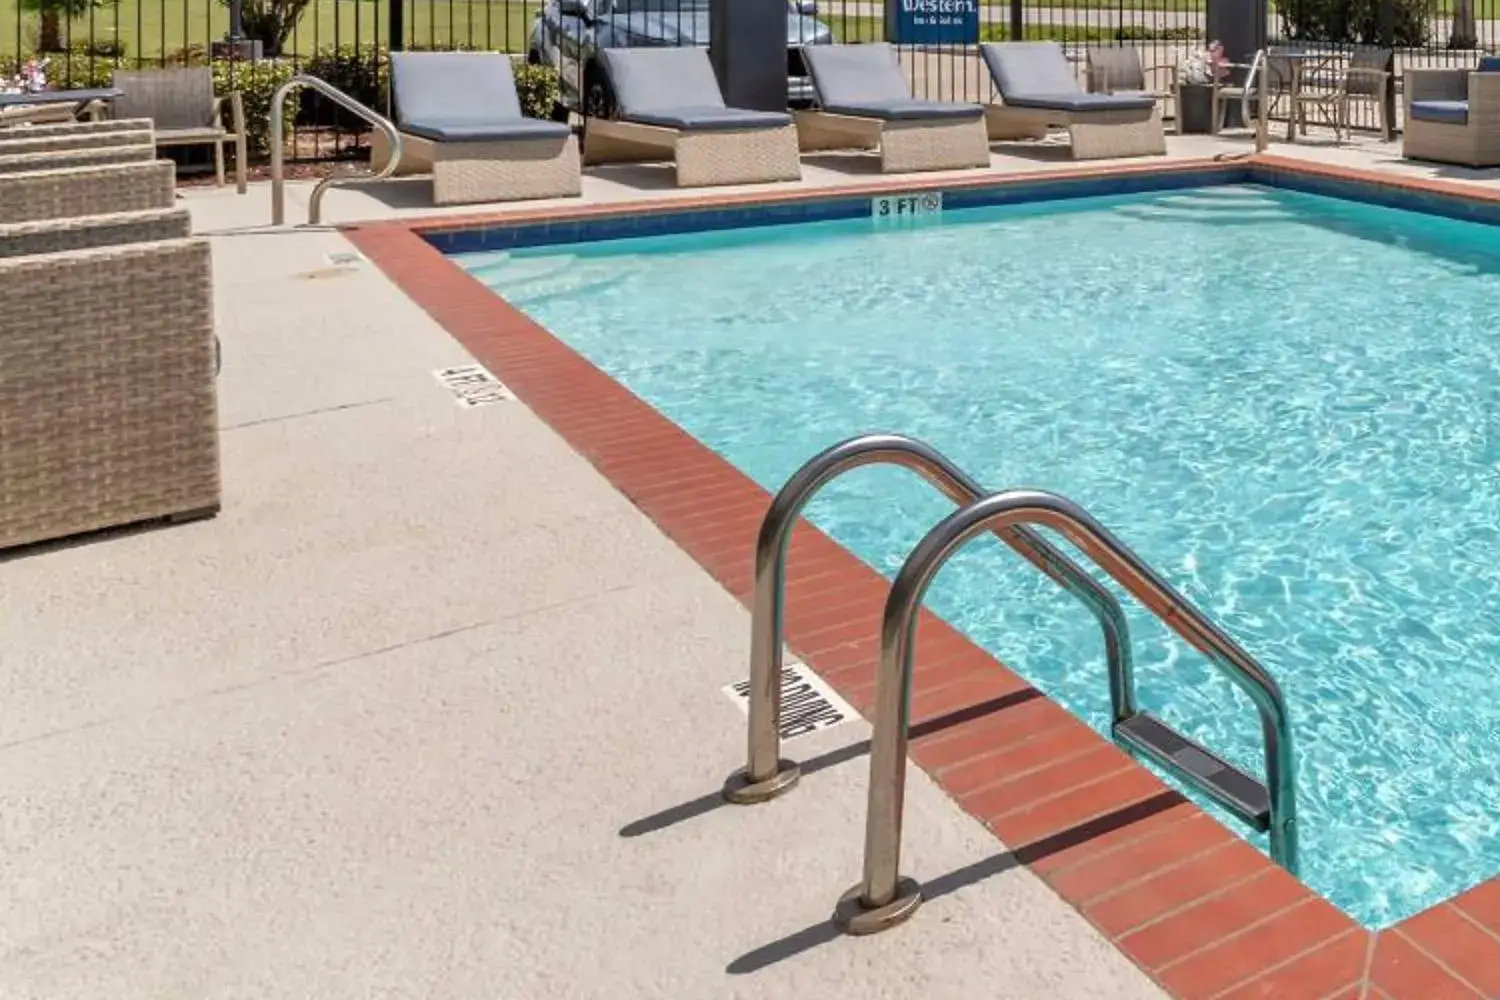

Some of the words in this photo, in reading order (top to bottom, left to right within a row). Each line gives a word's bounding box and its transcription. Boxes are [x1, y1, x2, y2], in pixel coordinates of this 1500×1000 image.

[880, 199, 889, 216] 3
[897, 197, 918, 215] FT
[779, 683, 845, 740] DIVING
